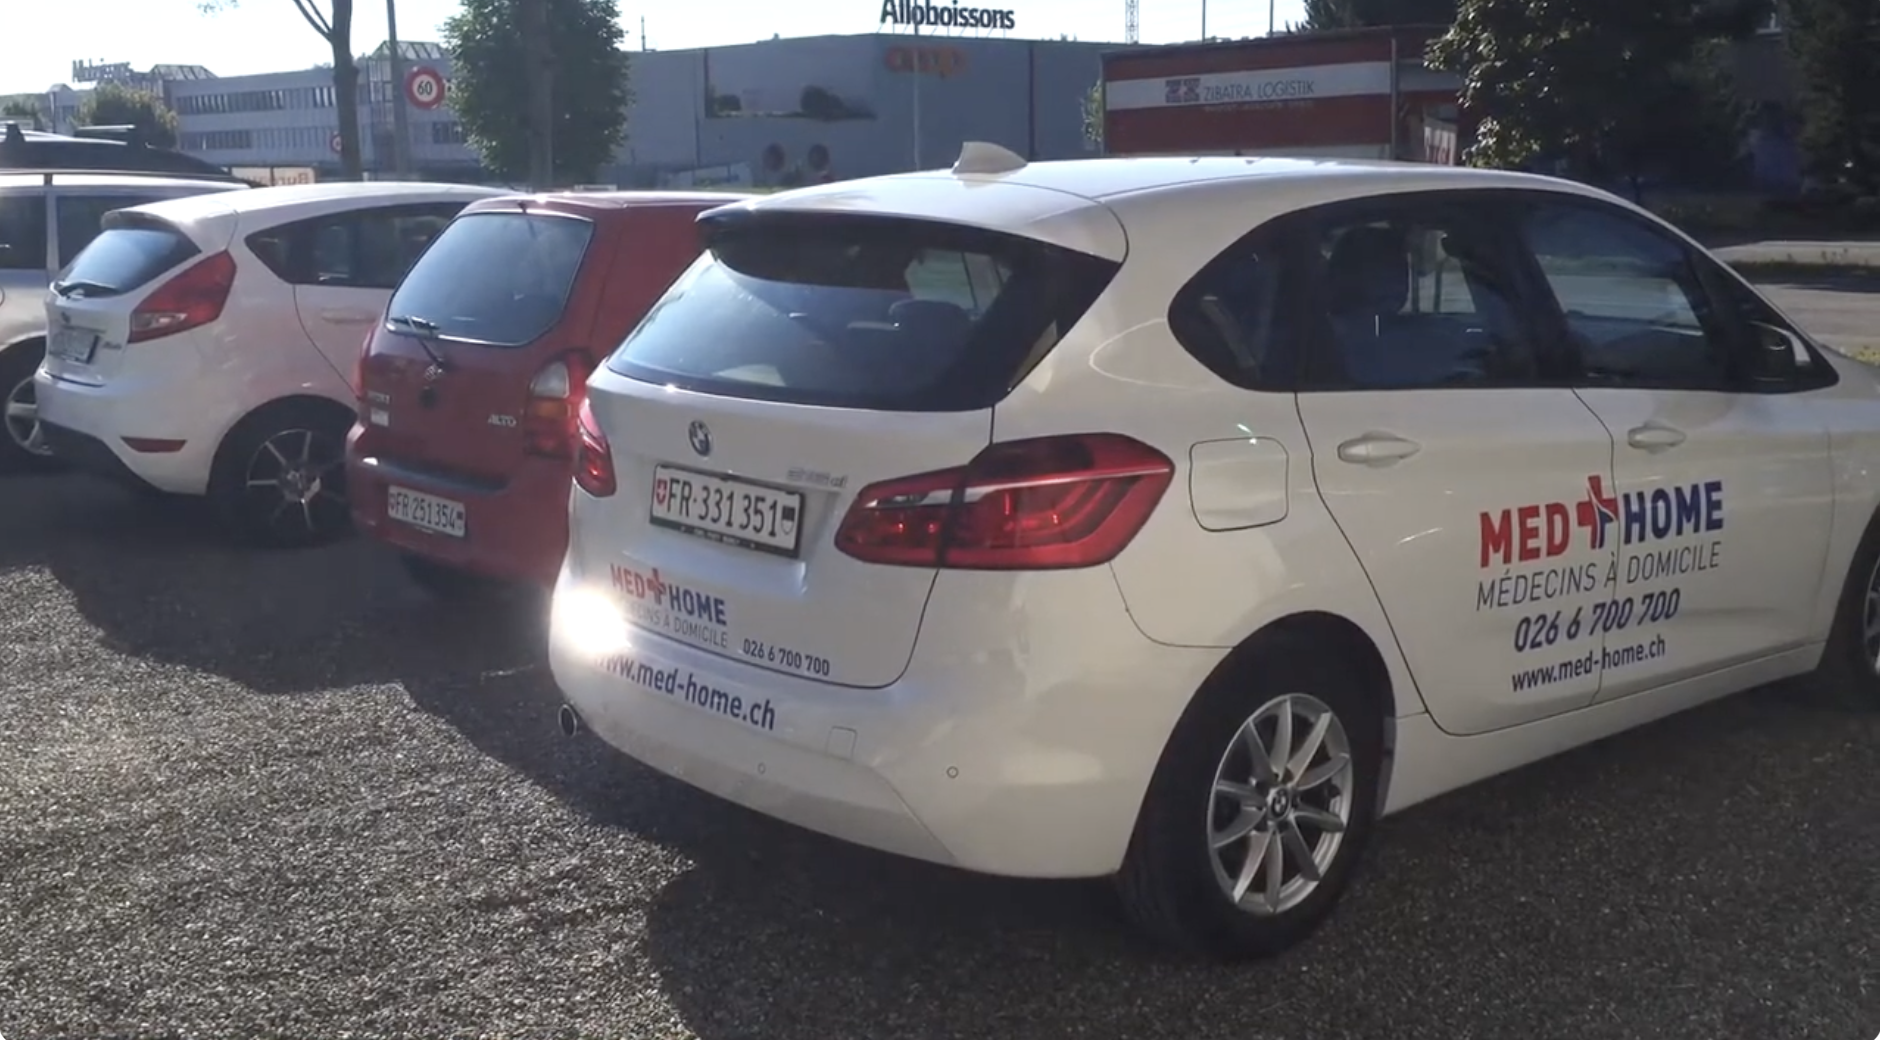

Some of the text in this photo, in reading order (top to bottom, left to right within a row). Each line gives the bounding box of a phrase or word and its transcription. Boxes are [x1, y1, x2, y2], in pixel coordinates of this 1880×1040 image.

[880, 0, 1015, 29] Alloboissons
[417, 80, 433, 96] 60
[1203, 80, 1315, 101] ZIBATRA LOGISTIK
[487, 413, 517, 428] ALTO
[1480, 480, 1724, 568] MED HOME
[609, 562, 728, 627] MED HOME
[1476, 541, 1722, 611] MÉDECINS À DOMICILE
[674, 616, 728, 648] DOMICILE
[1513, 588, 1681, 652] 026 6 700 700
[743, 637, 830, 677] 026 6 700 700
[1512, 634, 1666, 692] www.med-home.ch
